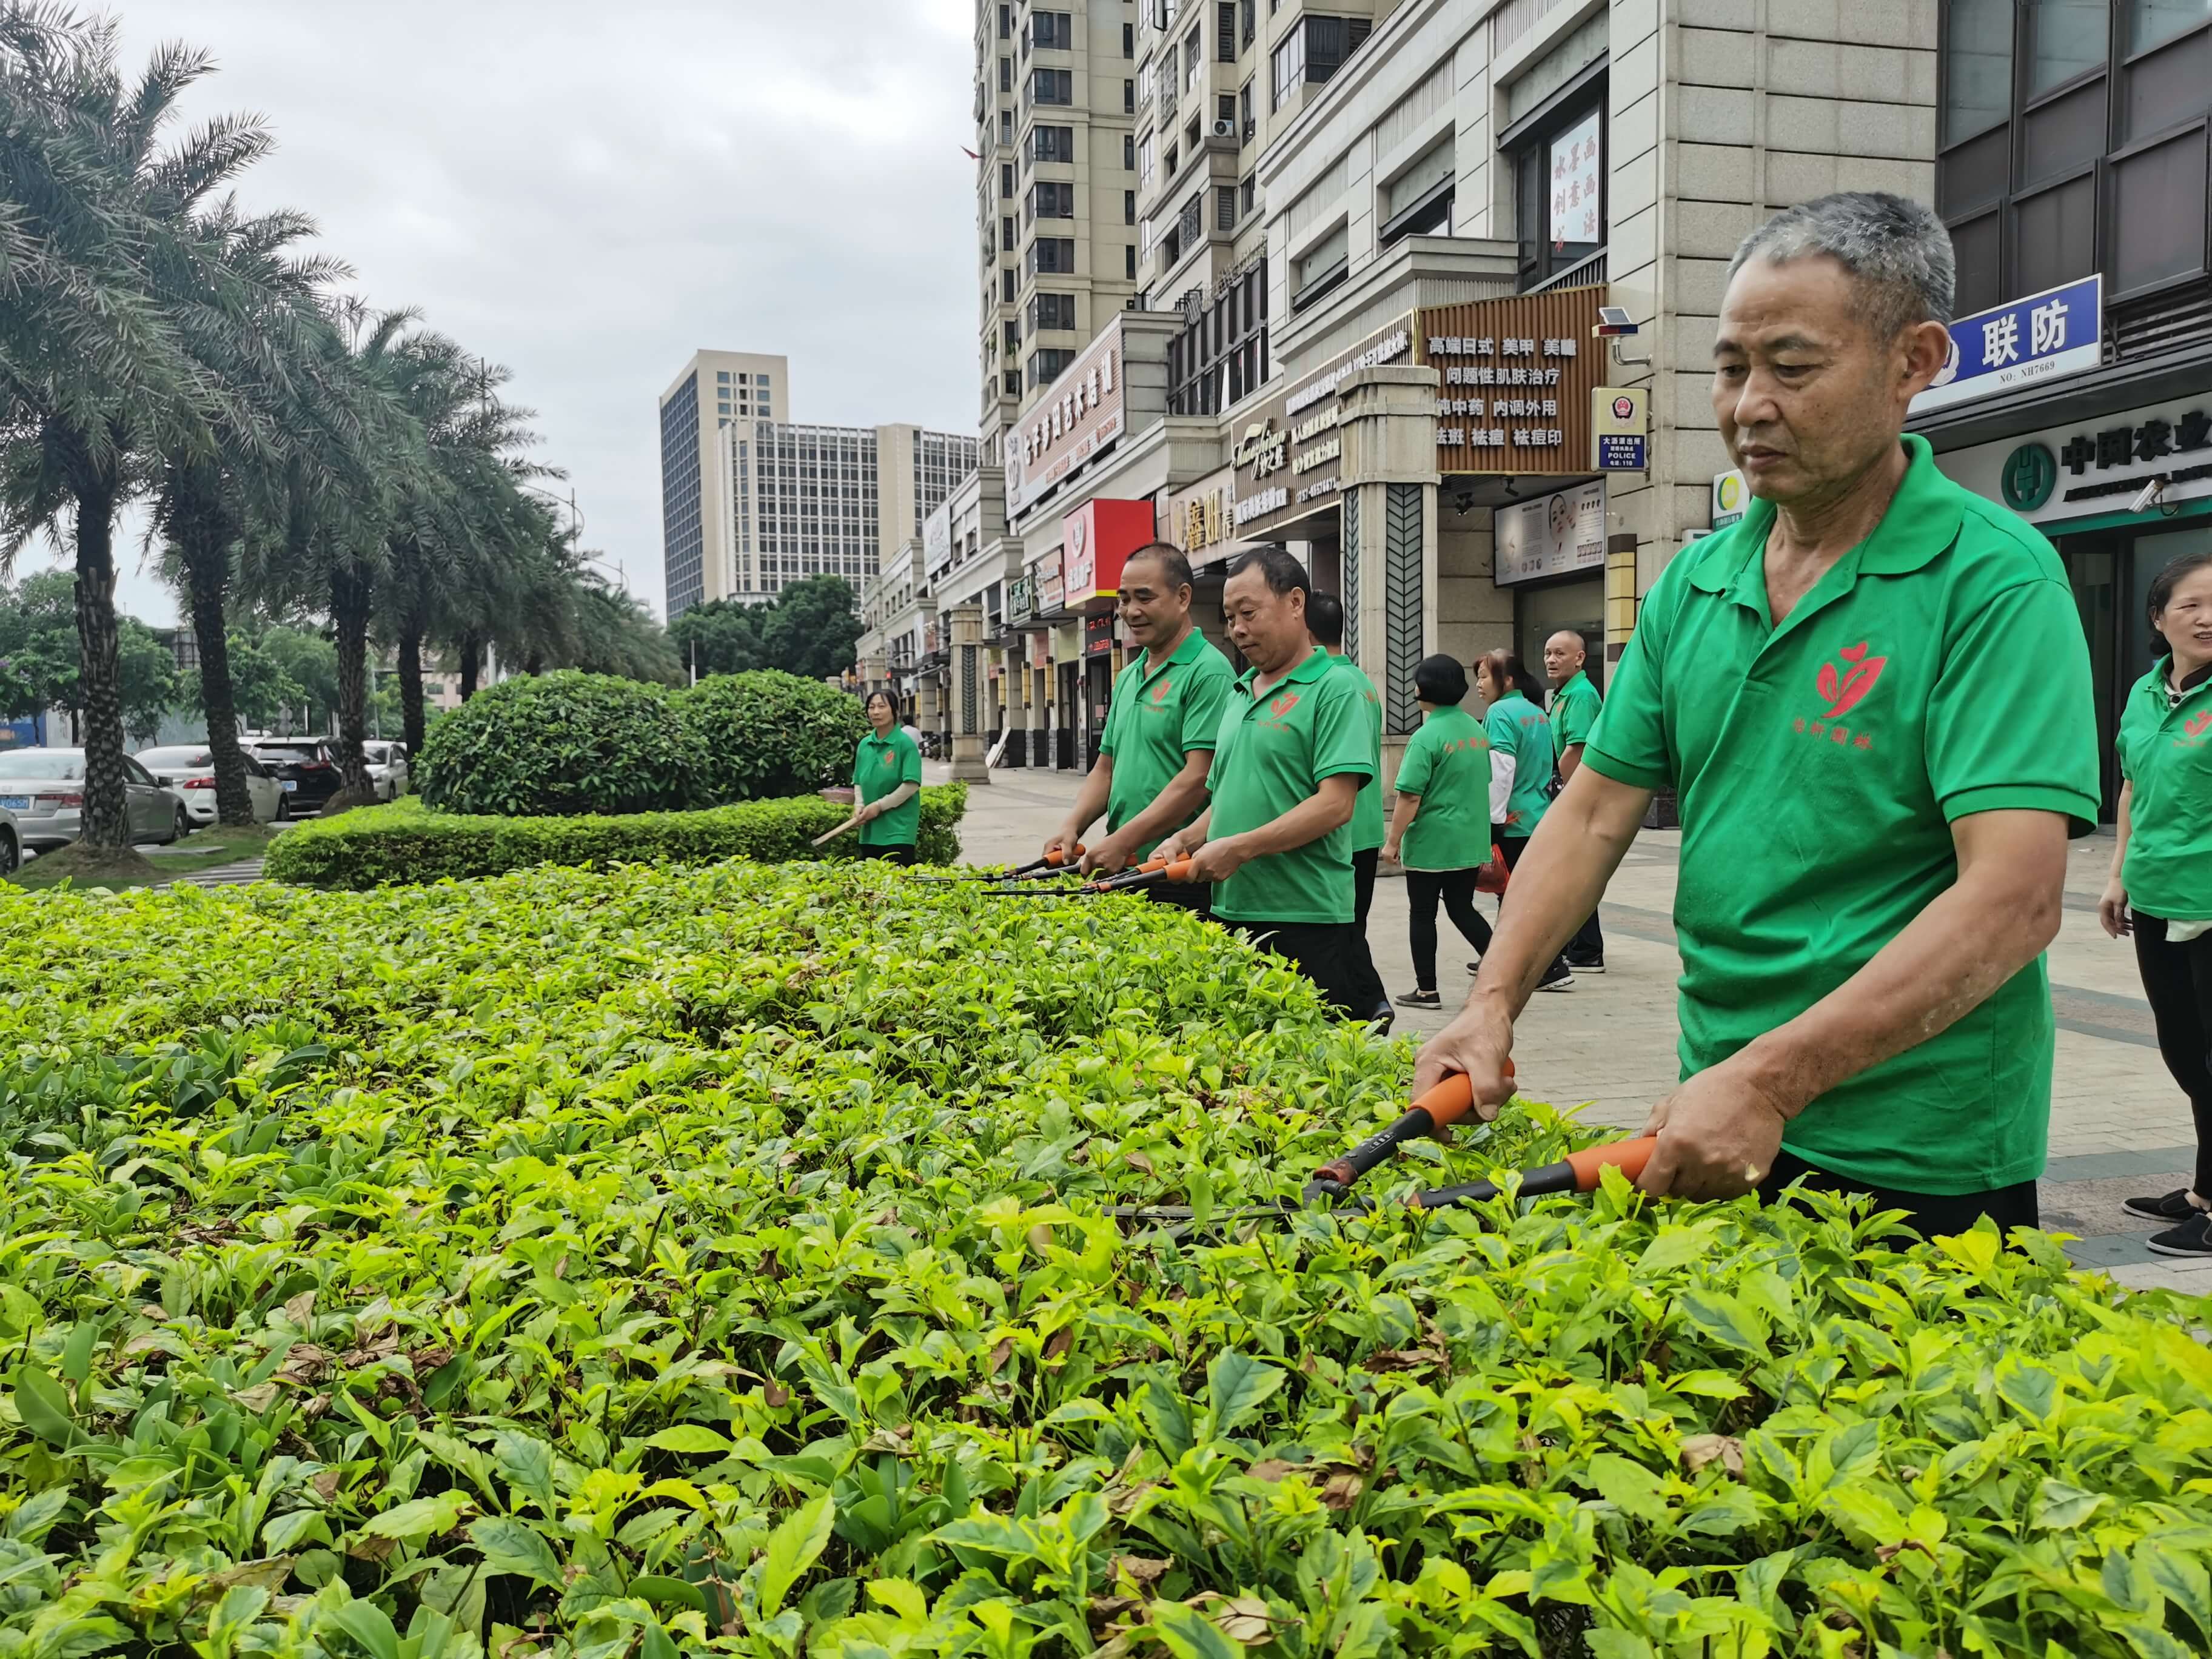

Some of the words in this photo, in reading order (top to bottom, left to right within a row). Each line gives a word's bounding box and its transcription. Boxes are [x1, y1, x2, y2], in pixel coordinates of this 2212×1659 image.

[1982, 300, 2068, 367] 联防
[1428, 337, 1494, 355] 高端日式
[1502, 338, 1534, 357] 美甲
[1446, 367, 1561, 386] 问题性肌肤治疗
[2021, 361, 2055, 378] NH7669
[1493, 398, 1557, 417] 内调外用
[1472, 427, 1505, 446] 祛痘
[1513, 427, 1563, 446] 祛痘印
